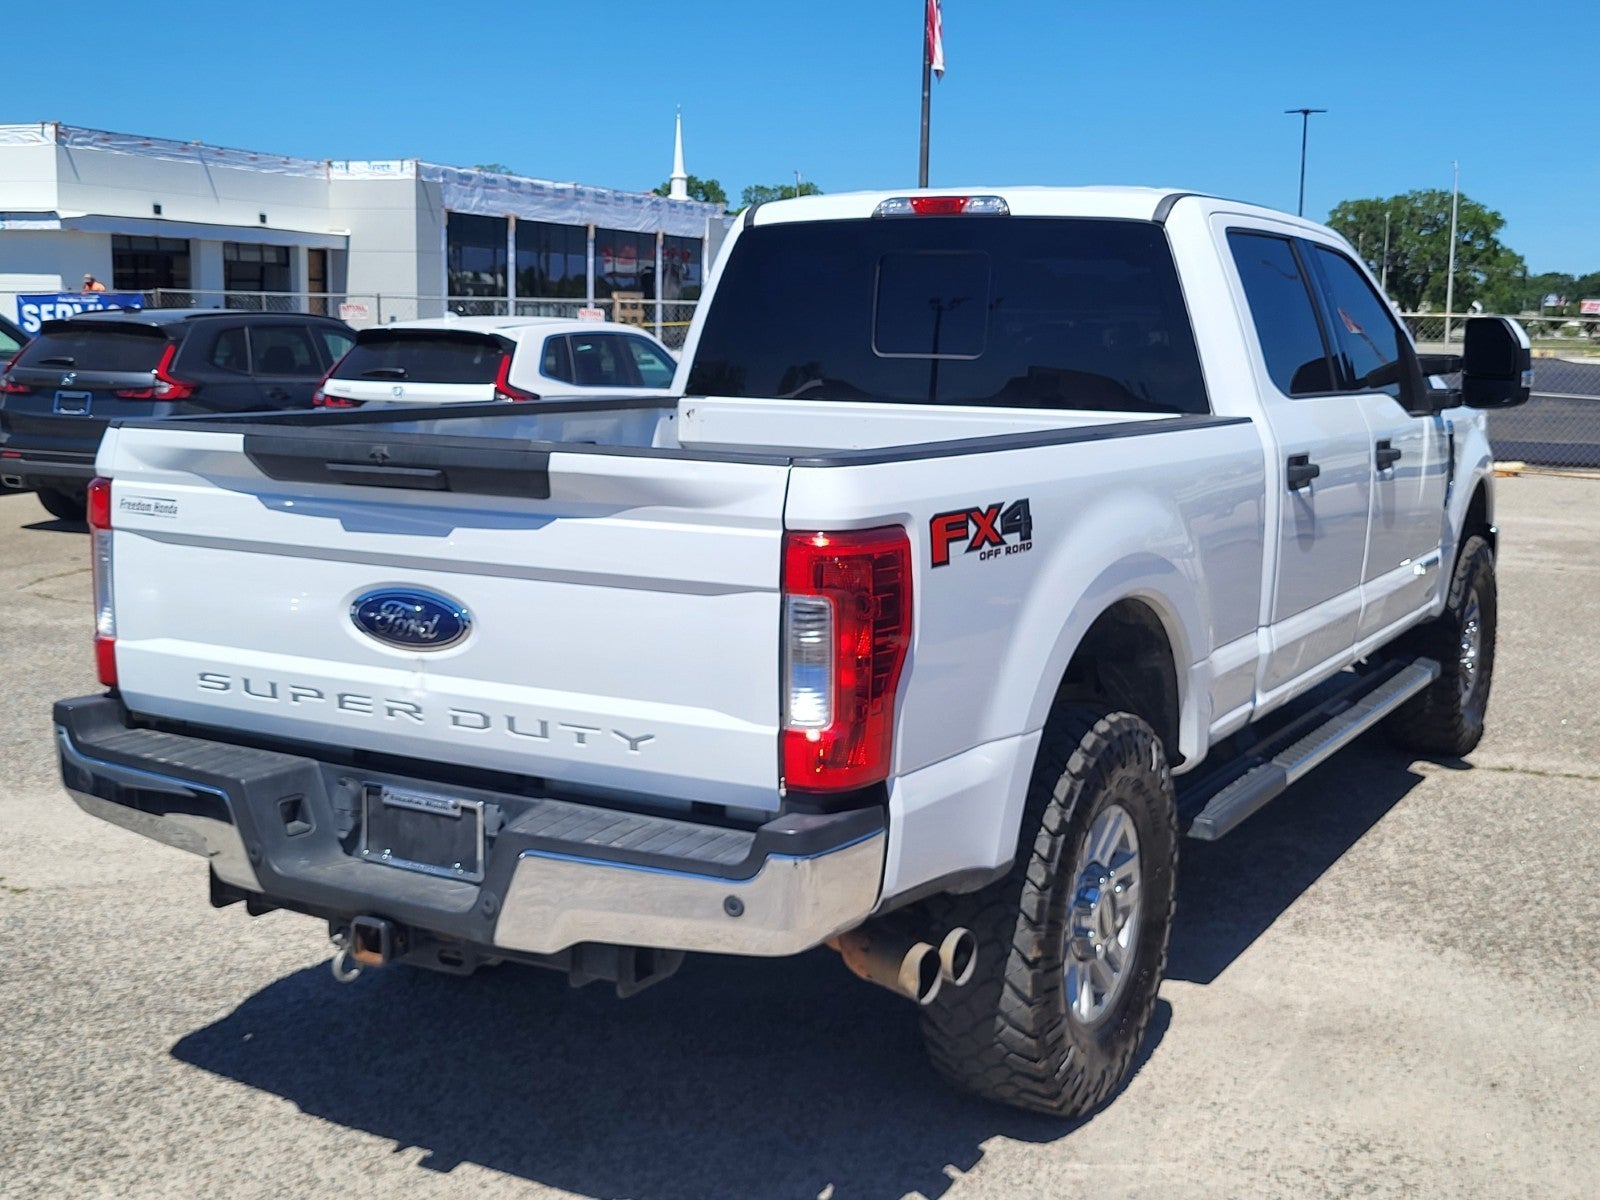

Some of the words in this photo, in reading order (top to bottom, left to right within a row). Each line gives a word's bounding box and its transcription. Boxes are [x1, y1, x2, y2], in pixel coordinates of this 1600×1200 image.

[120, 498, 152, 512] Freedom
[154, 502, 178, 515] Honda
[929, 498, 1032, 569] FX4
[979, 548, 1002, 561] OFF
[1005, 541, 1033, 556] ROAD
[374, 599, 441, 640] Ford
[198, 672, 424, 725] SUPER
[448, 706, 656, 753] DUTY
